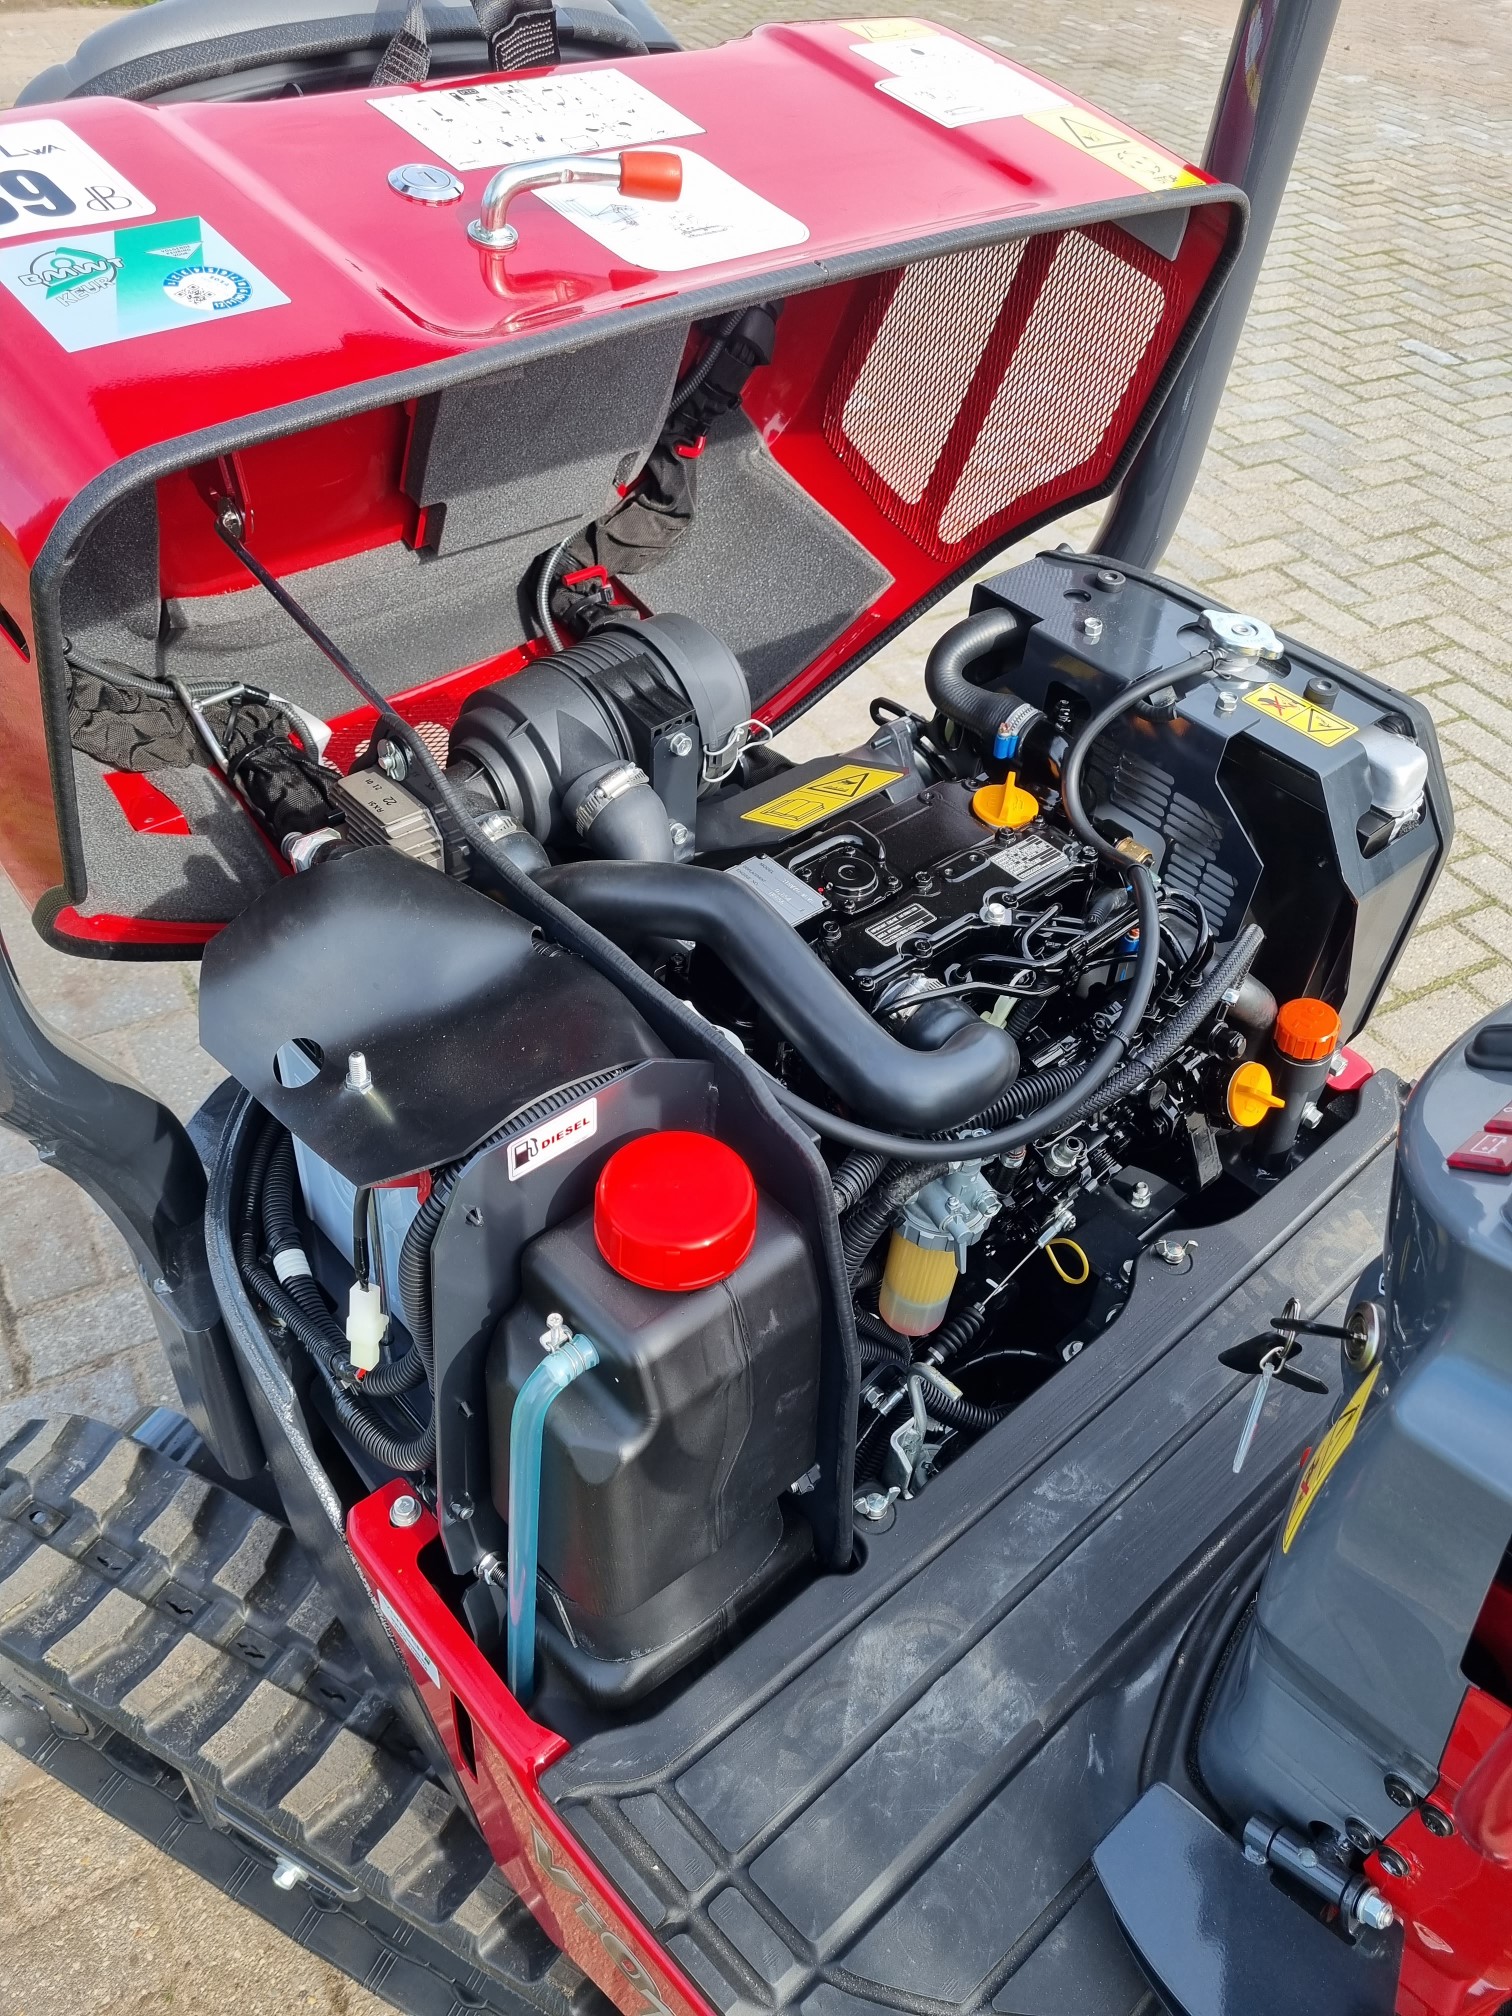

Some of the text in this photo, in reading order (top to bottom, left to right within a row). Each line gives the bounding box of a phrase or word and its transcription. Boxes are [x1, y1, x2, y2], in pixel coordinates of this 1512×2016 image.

[85, 186, 133, 212] dB
[18, 257, 125, 287] BMWT
[55, 276, 117, 308] KEUR
[382, 795, 398, 806] 22
[541, 1117, 591, 1150] DIESEL
